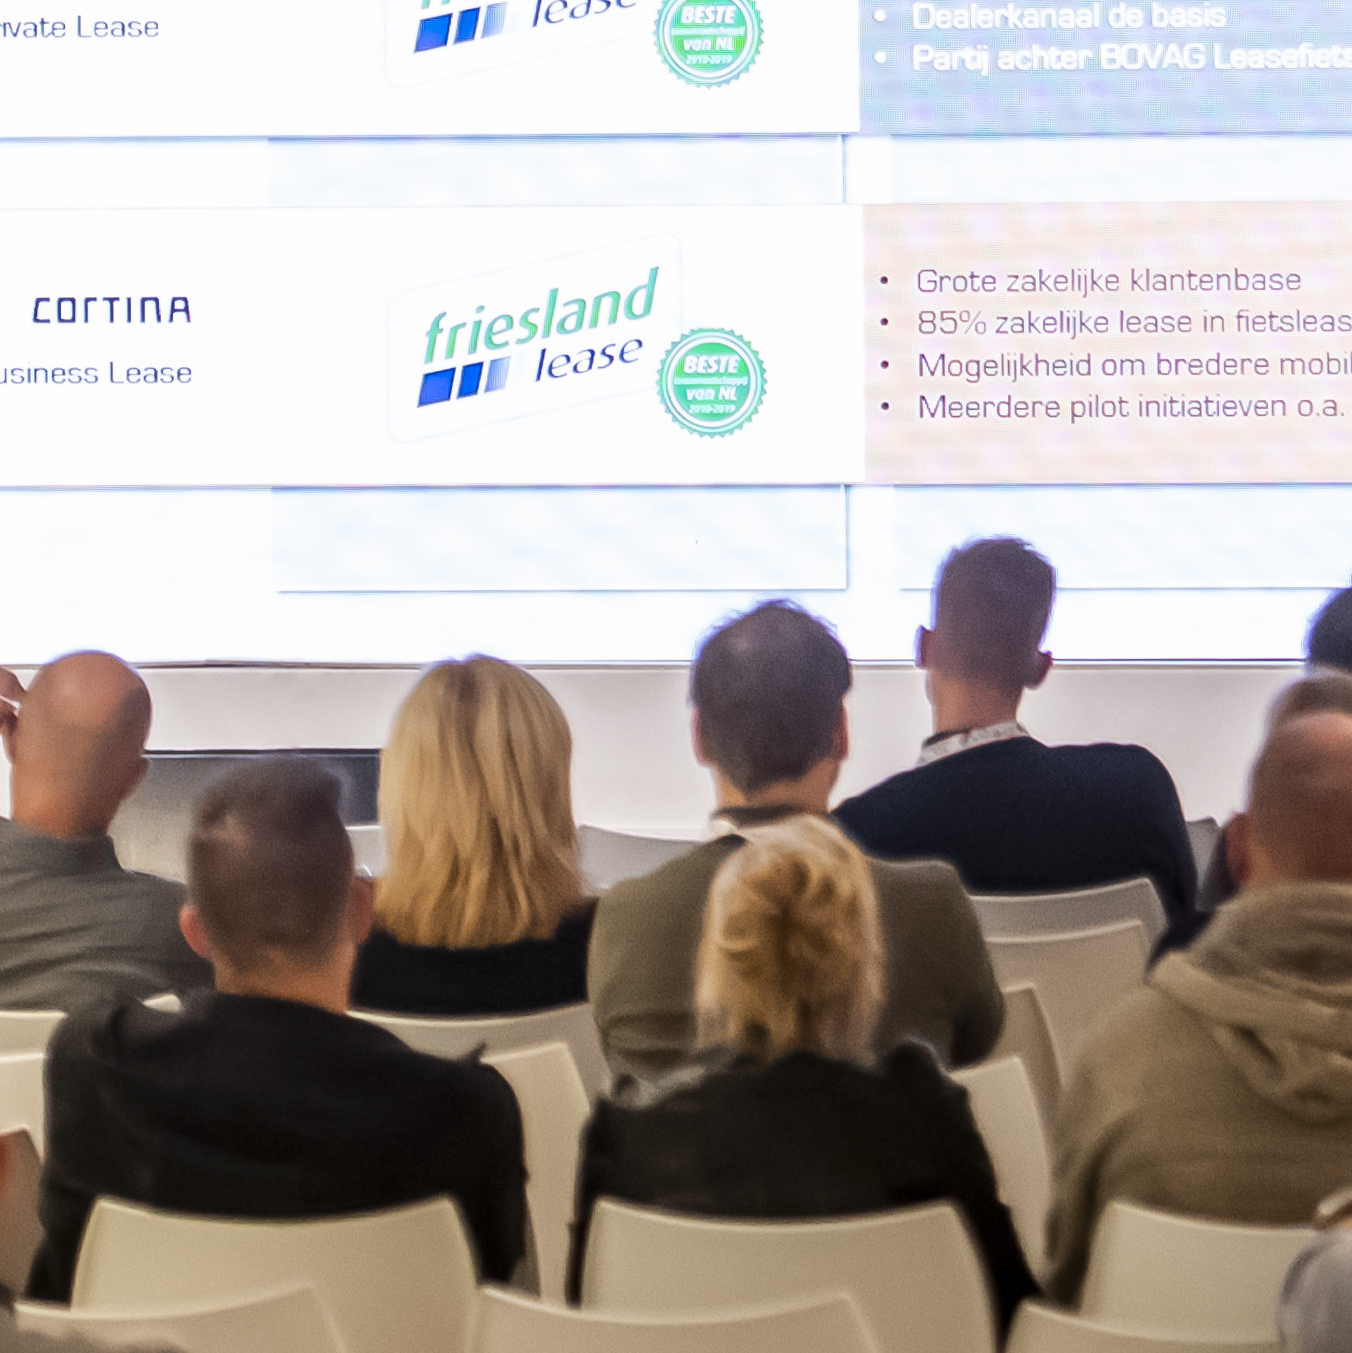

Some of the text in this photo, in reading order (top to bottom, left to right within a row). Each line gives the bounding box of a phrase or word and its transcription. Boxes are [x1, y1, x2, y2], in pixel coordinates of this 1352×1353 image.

[78, 16, 158, 37] Lease
[680, 5, 737, 24] BESTE
[912, 2, 1226, 29] Dealerkanaal de basis
[912, 45, 988, 76] Partij
[998, 44, 1093, 70] achter
[1099, 42, 1205, 69] BOVAG
[918, 268, 1300, 298] Grote zakelijke klantenbase
[33, 297, 190, 323] CORTINA
[422, 267, 660, 364] friesland
[919, 311, 986, 334] 85%
[996, 311, 1108, 339] zakelijke
[1120, 310, 1191, 333] lease
[1203, 309, 1225, 333] in
[535, 333, 643, 383] lease
[683, 355, 740, 374] BESTE
[919, 353, 1091, 383] Mogelijkheid
[1102, 359, 1145, 376] om
[1157, 352, 1269, 375] bredere
[110, 362, 191, 383] Lease
[686, 386, 737, 401] van NL
[920, 395, 1060, 418] Meerdere
[1071, 395, 1129, 424] pilot
[1139, 396, 1286, 417] initiatieven
[1298, 400, 1344, 416] o.a.
